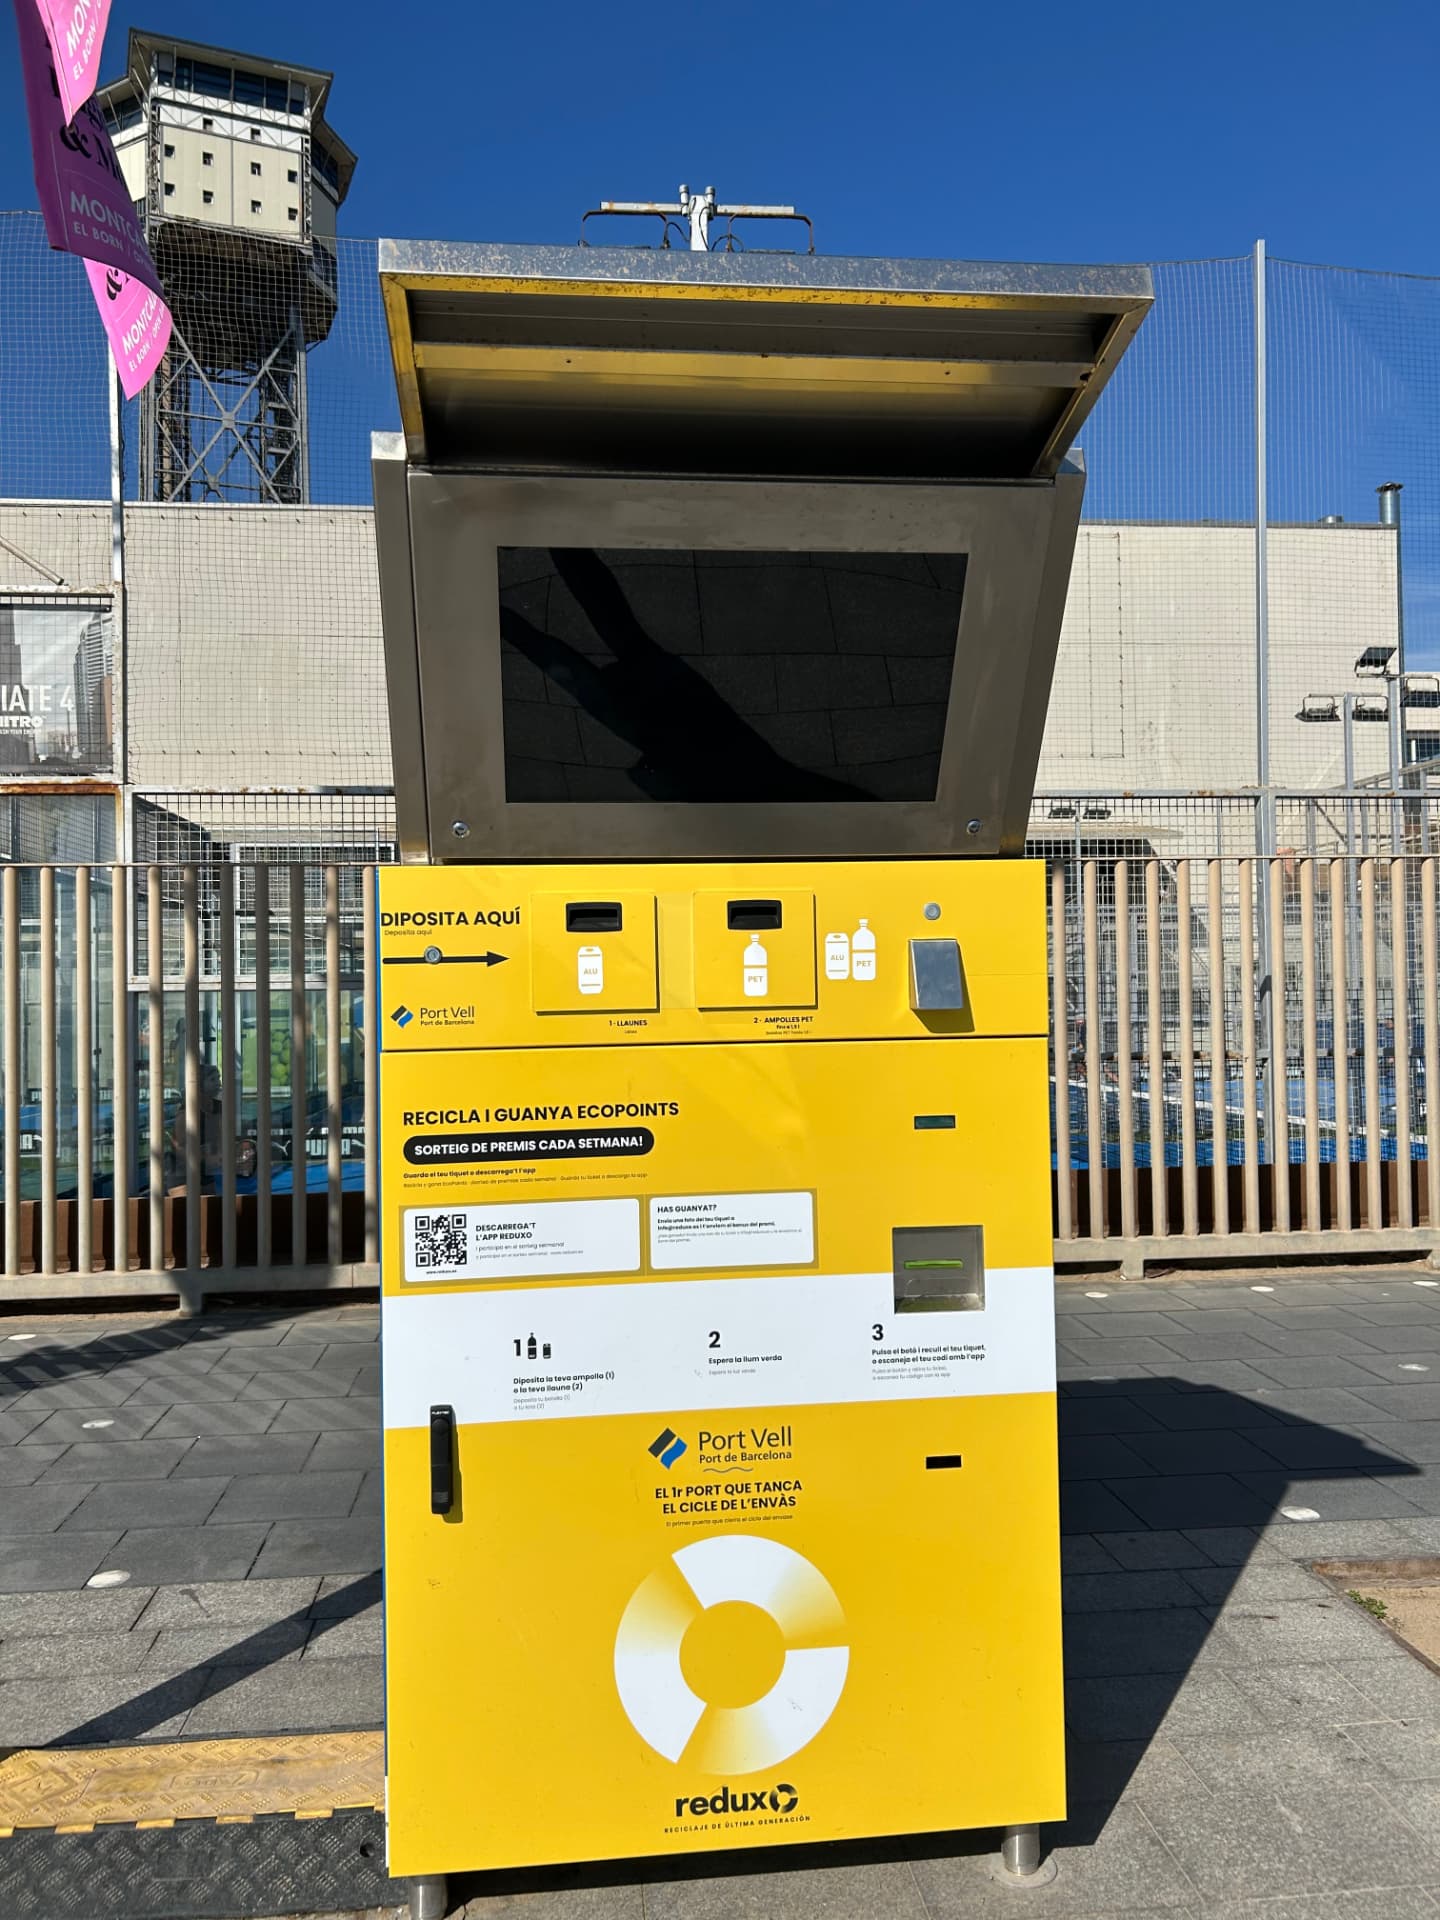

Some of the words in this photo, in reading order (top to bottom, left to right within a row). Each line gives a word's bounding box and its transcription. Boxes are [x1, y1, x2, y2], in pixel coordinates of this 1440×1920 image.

[72, 61, 84, 80] EL
[73, 221, 88, 237] EL
[93, 227, 124, 251] BORN
[60, 685, 76, 712] 4
[381, 912, 469, 926] DIPOSITA
[473, 906, 520, 927] AQUÍ
[420, 1007, 448, 1019] Port
[450, 1005, 475, 1018] Vell
[403, 1109, 480, 1126] RECICLA
[485, 1109, 490, 1122] I
[495, 1105, 573, 1122] GUANYA
[577, 1102, 679, 1119] ECOPOINTS
[414, 1143, 469, 1156] SORTEIG
[471, 1142, 488, 1153] DE
[490, 1140, 537, 1153] PREMIS
[538, 1138, 576, 1151] CADA
[578, 1136, 643, 1149] SETMANA!
[449, 1169, 468, 1178] tiquet
[675, 1204, 717, 1212] GUANYAT?
[476, 1223, 536, 1232] DESCARREGA'T
[500, 1232, 532, 1240] REDUXO
[708, 1331, 721, 1348] 2
[872, 1324, 884, 1341] 3
[514, 1339, 521, 1356] 1
[872, 1348, 892, 1356] Pulsa
[900, 1346, 917, 1354] botó
[708, 1357, 734, 1365] Espera
[743, 1355, 760, 1363] llum
[878, 1356, 911, 1364] escaneja
[966, 1353, 985, 1361] l'app
[513, 1376, 545, 1385] Diposita
[572, 1373, 604, 1382] ampolla
[605, 1371, 615, 1380] (1)
[546, 1384, 570, 1392] llauna
[572, 1382, 583, 1391] (2)
[699, 1430, 746, 1451] Port
[751, 1425, 792, 1448] Vell
[699, 1454, 722, 1464] Port
[724, 1453, 737, 1462] de
[741, 1450, 792, 1462] Barcelona
[655, 1488, 669, 1499] EL
[672, 1487, 683, 1498] 1r
[686, 1485, 721, 1497] PORT
[724, 1482, 752, 1495] QUE
[754, 1480, 803, 1493] TANCA
[663, 1503, 676, 1514] EL
[679, 1501, 718, 1514] CICLE
[721, 1500, 737, 1511] DE
[740, 1494, 796, 1510] L'ENVÀS
[664, 1823, 708, 1833] RECICLAJE
[725, 1820, 755, 1829] ÚLTIMA
[758, 1815, 811, 1825] GENERACIÓN
